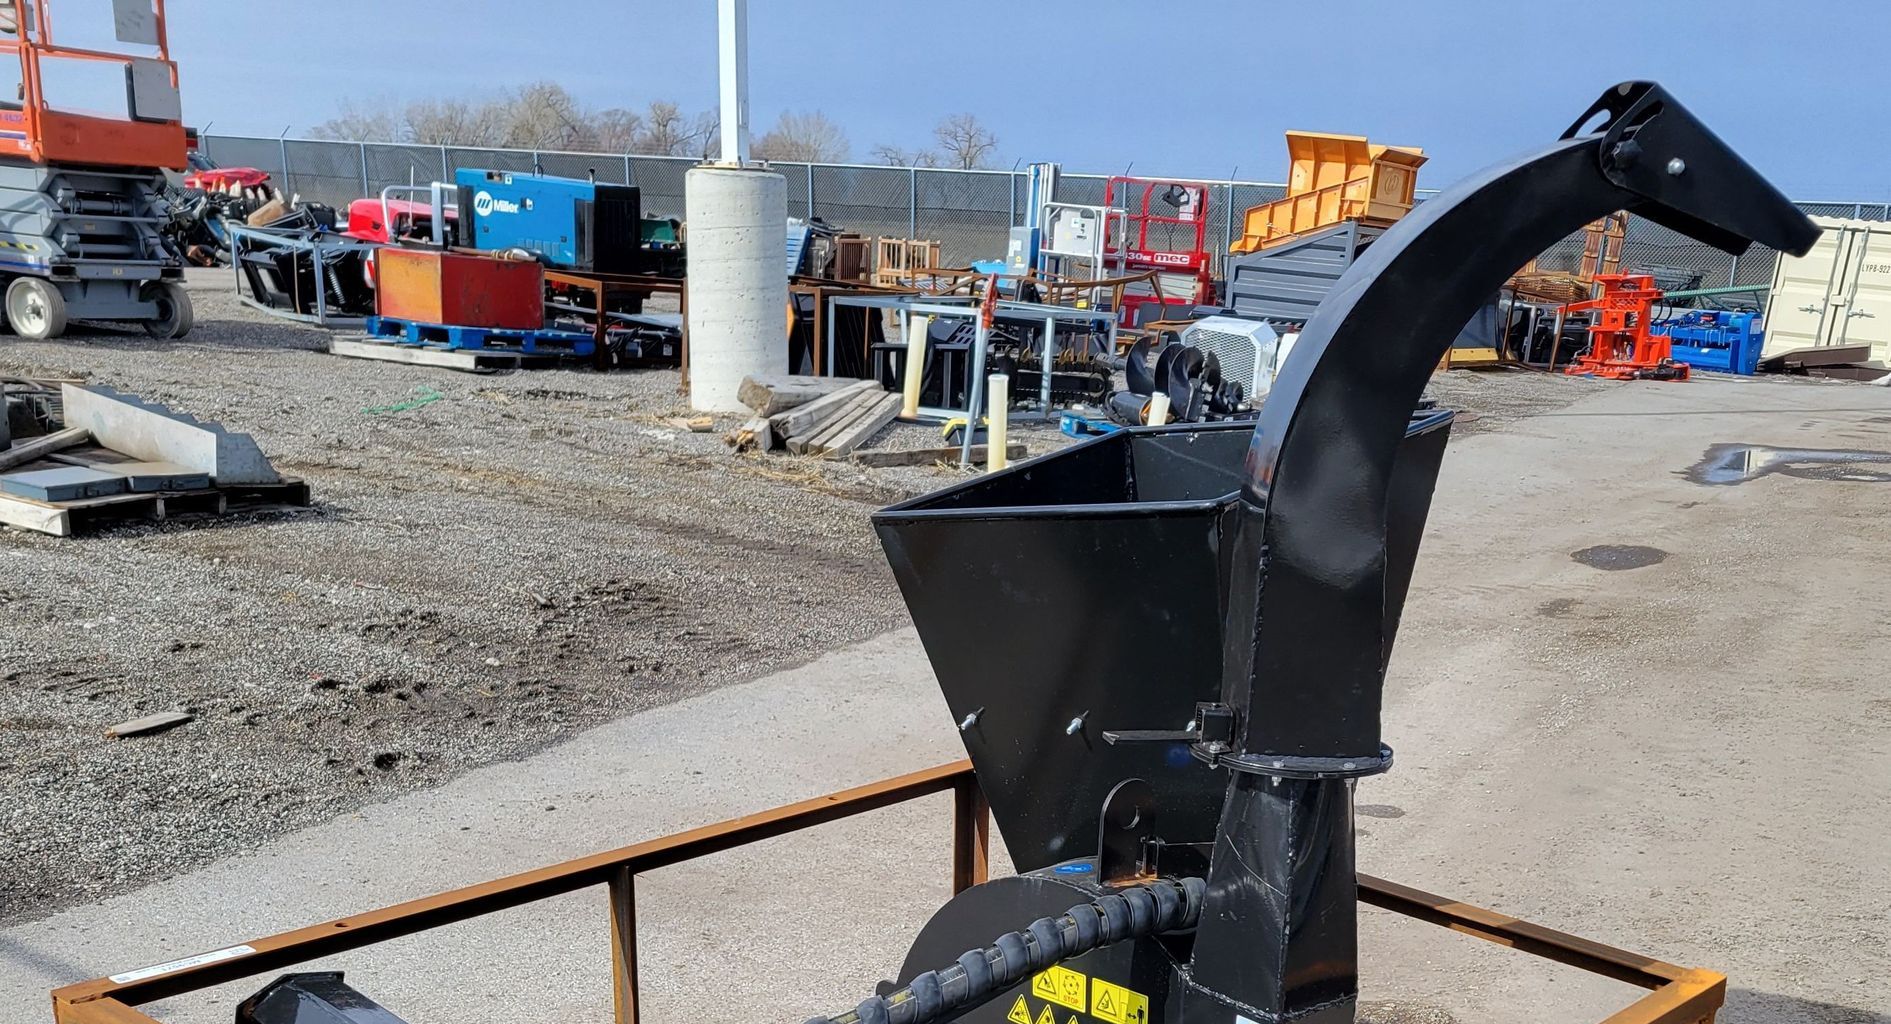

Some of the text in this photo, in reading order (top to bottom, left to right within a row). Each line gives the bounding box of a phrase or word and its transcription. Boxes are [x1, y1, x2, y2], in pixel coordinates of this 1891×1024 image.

[494, 199, 519, 214] Miller
[1155, 253, 1189, 264] mec
[1063, 995, 1079, 1005] STOP
